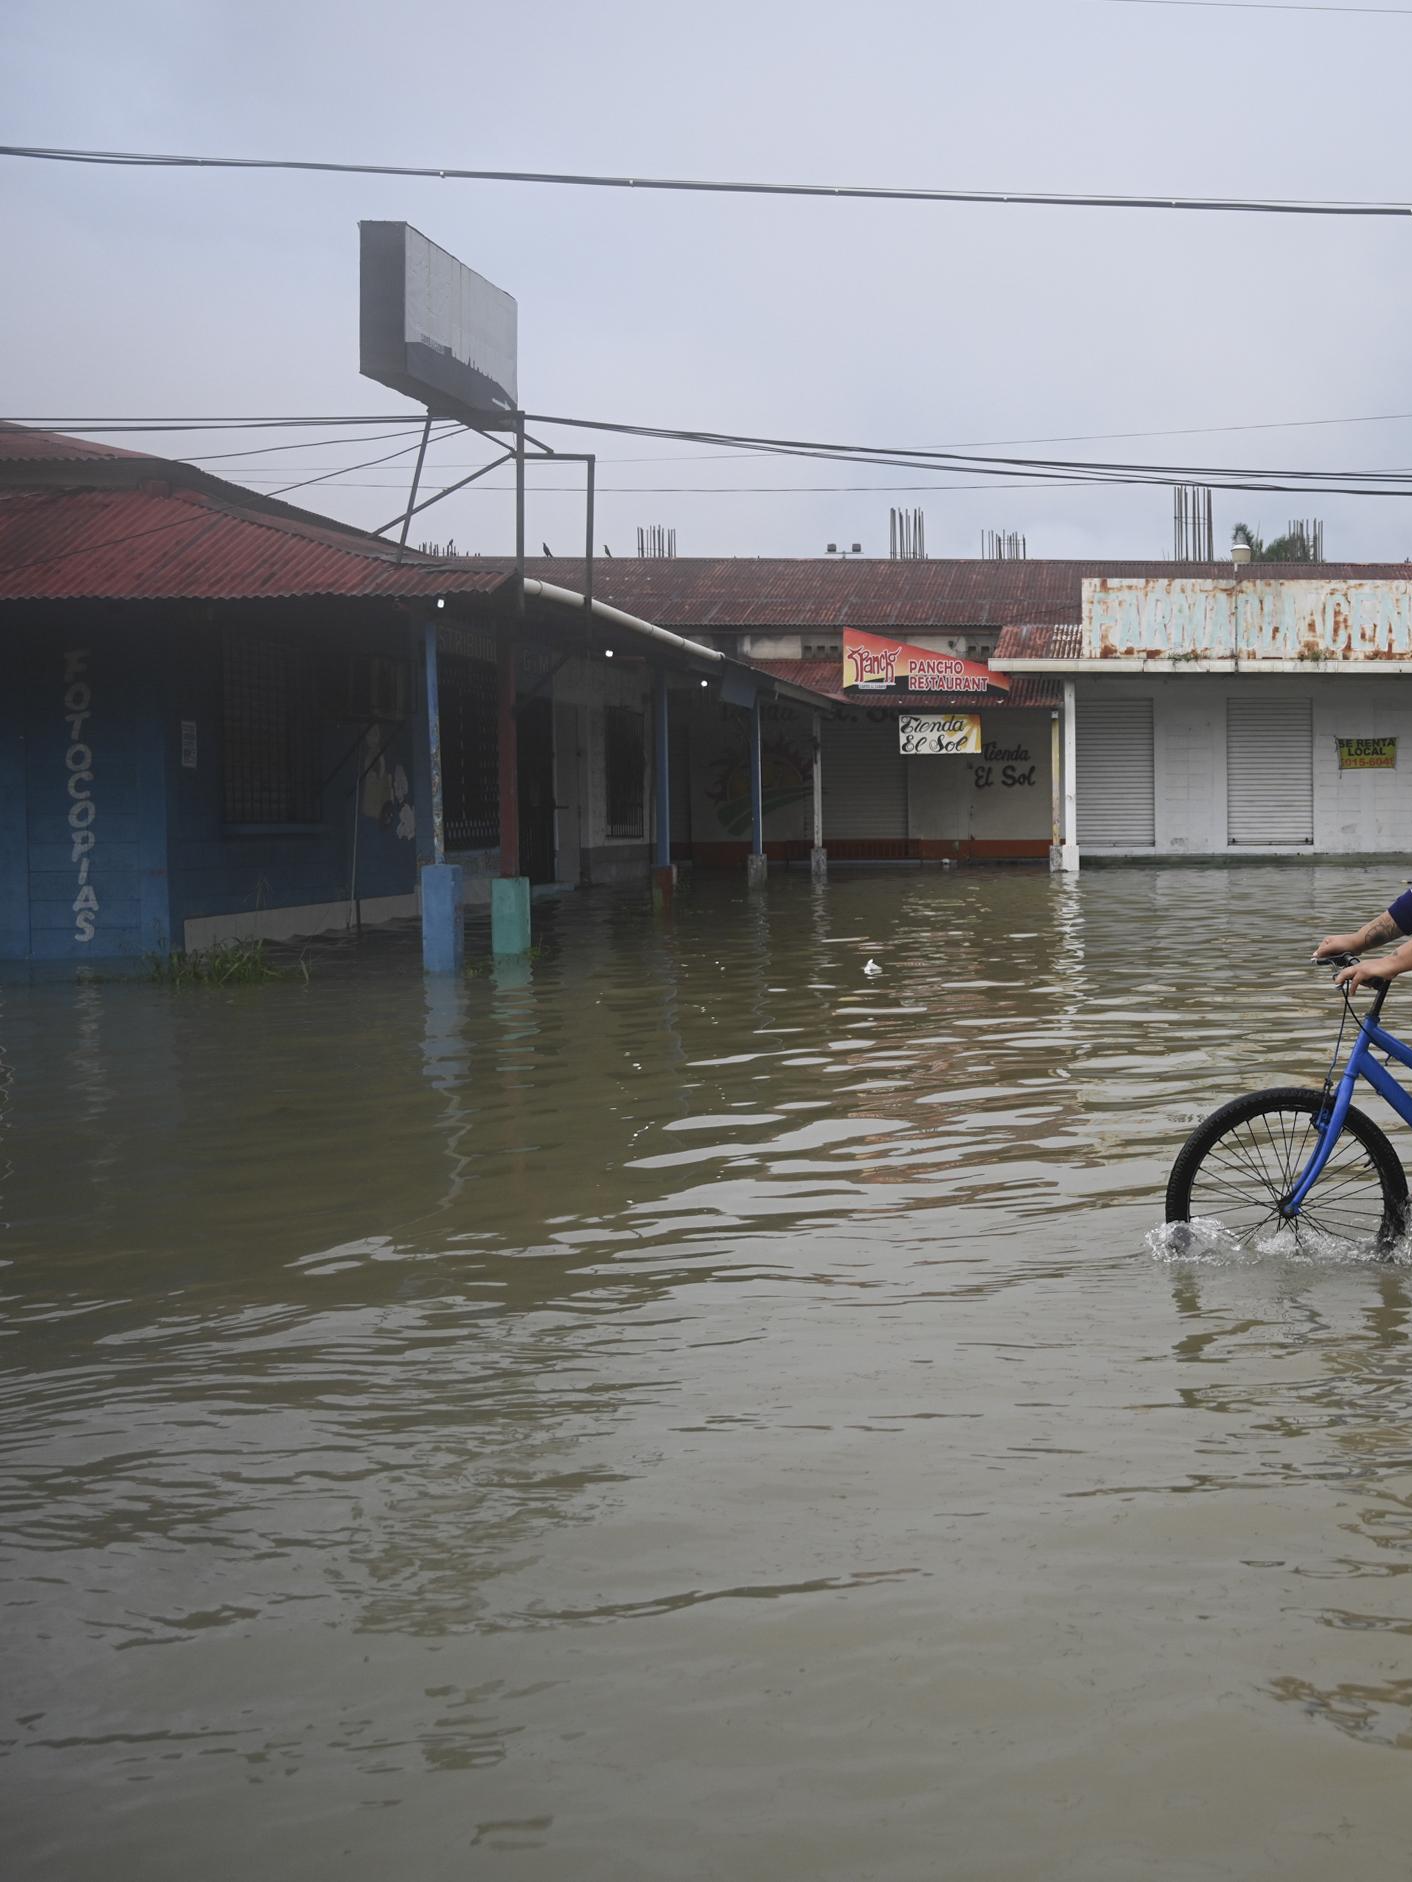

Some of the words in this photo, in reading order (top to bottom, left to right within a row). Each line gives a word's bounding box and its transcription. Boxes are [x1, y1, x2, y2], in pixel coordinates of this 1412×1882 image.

[1090, 590, 1300, 650] FARMACIA
[908, 660, 964, 675] PANCHO
[908, 676, 988, 691] RESTAURANT
[900, 715, 964, 734] Tienda
[901, 735, 928, 752] El
[929, 735, 968, 752] Sol
[1338, 738, 1353, 748] SE
[1357, 737, 1396, 748] RENTA
[982, 742, 1031, 762] Tienda
[1348, 747, 1386, 757] LOCAL
[974, 766, 994, 788] El
[1001, 765, 1036, 788] Sol
[64, 649, 99, 943] FOTOCOPIAS
